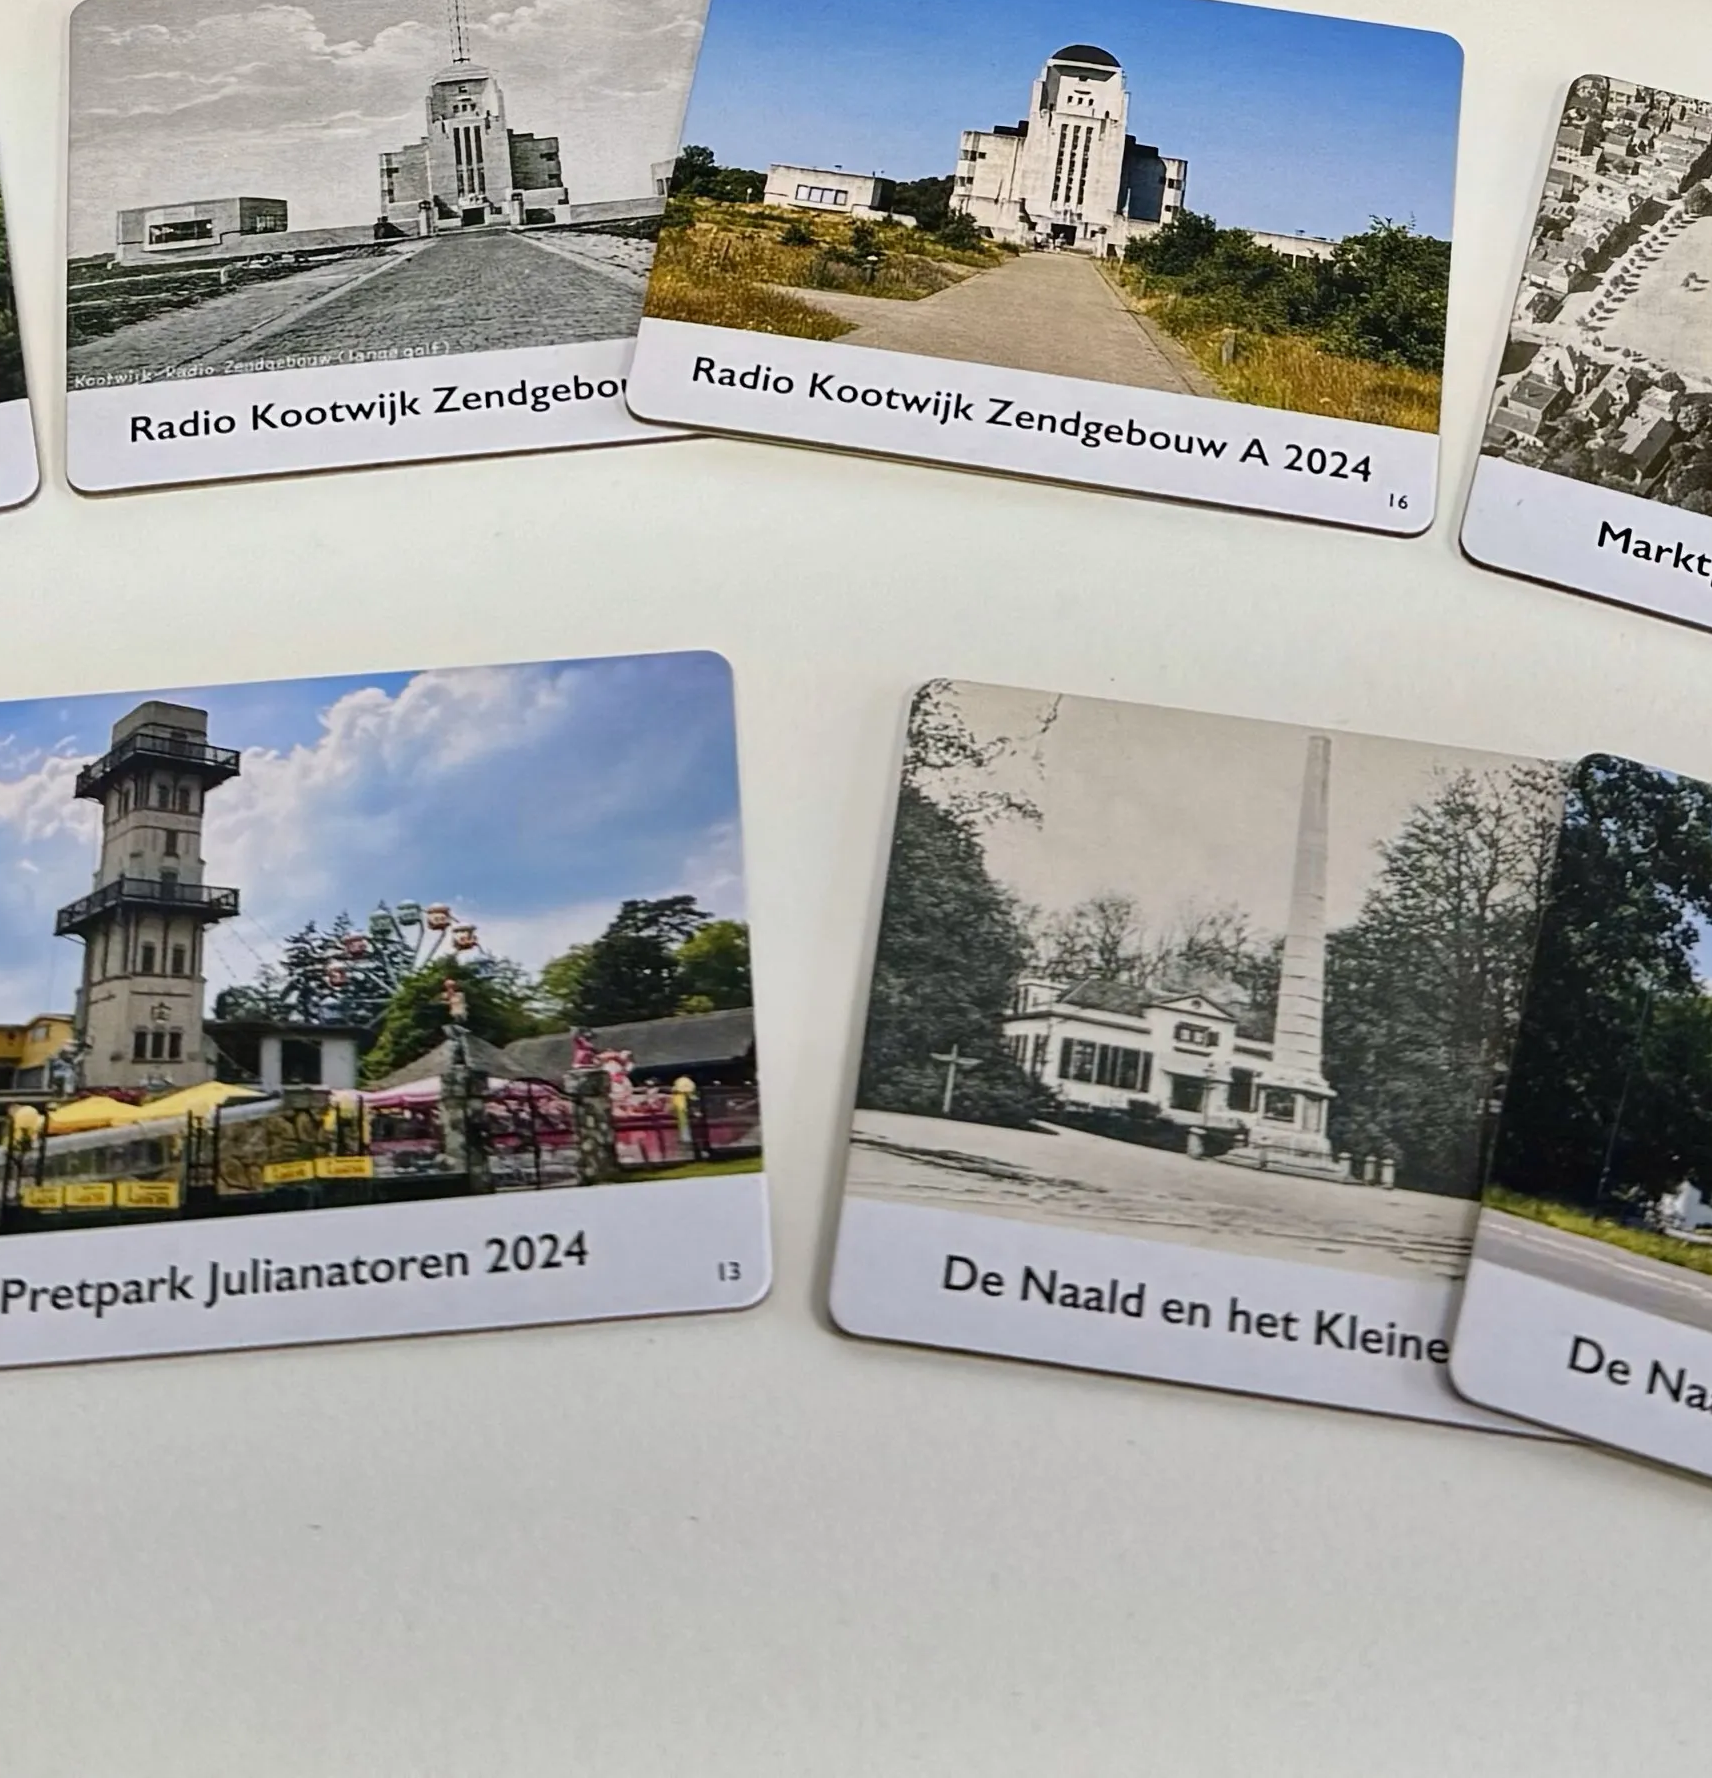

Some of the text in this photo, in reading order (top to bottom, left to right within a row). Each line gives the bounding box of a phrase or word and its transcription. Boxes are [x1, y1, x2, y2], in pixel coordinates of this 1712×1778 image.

[132, 375, 627, 442] Radio Kootwijk Zendgebo
[693, 357, 1371, 482] Radio Kootwijk Zendgebouw A 2024
[1389, 493, 1408, 510] 16
[2, 1232, 587, 1318] Pretpark Julianatoren 2024
[718, 1261, 741, 1281] 13
[944, 1255, 1450, 1364] De Naald en het Kleine
[1569, 1336, 1629, 1385] De
